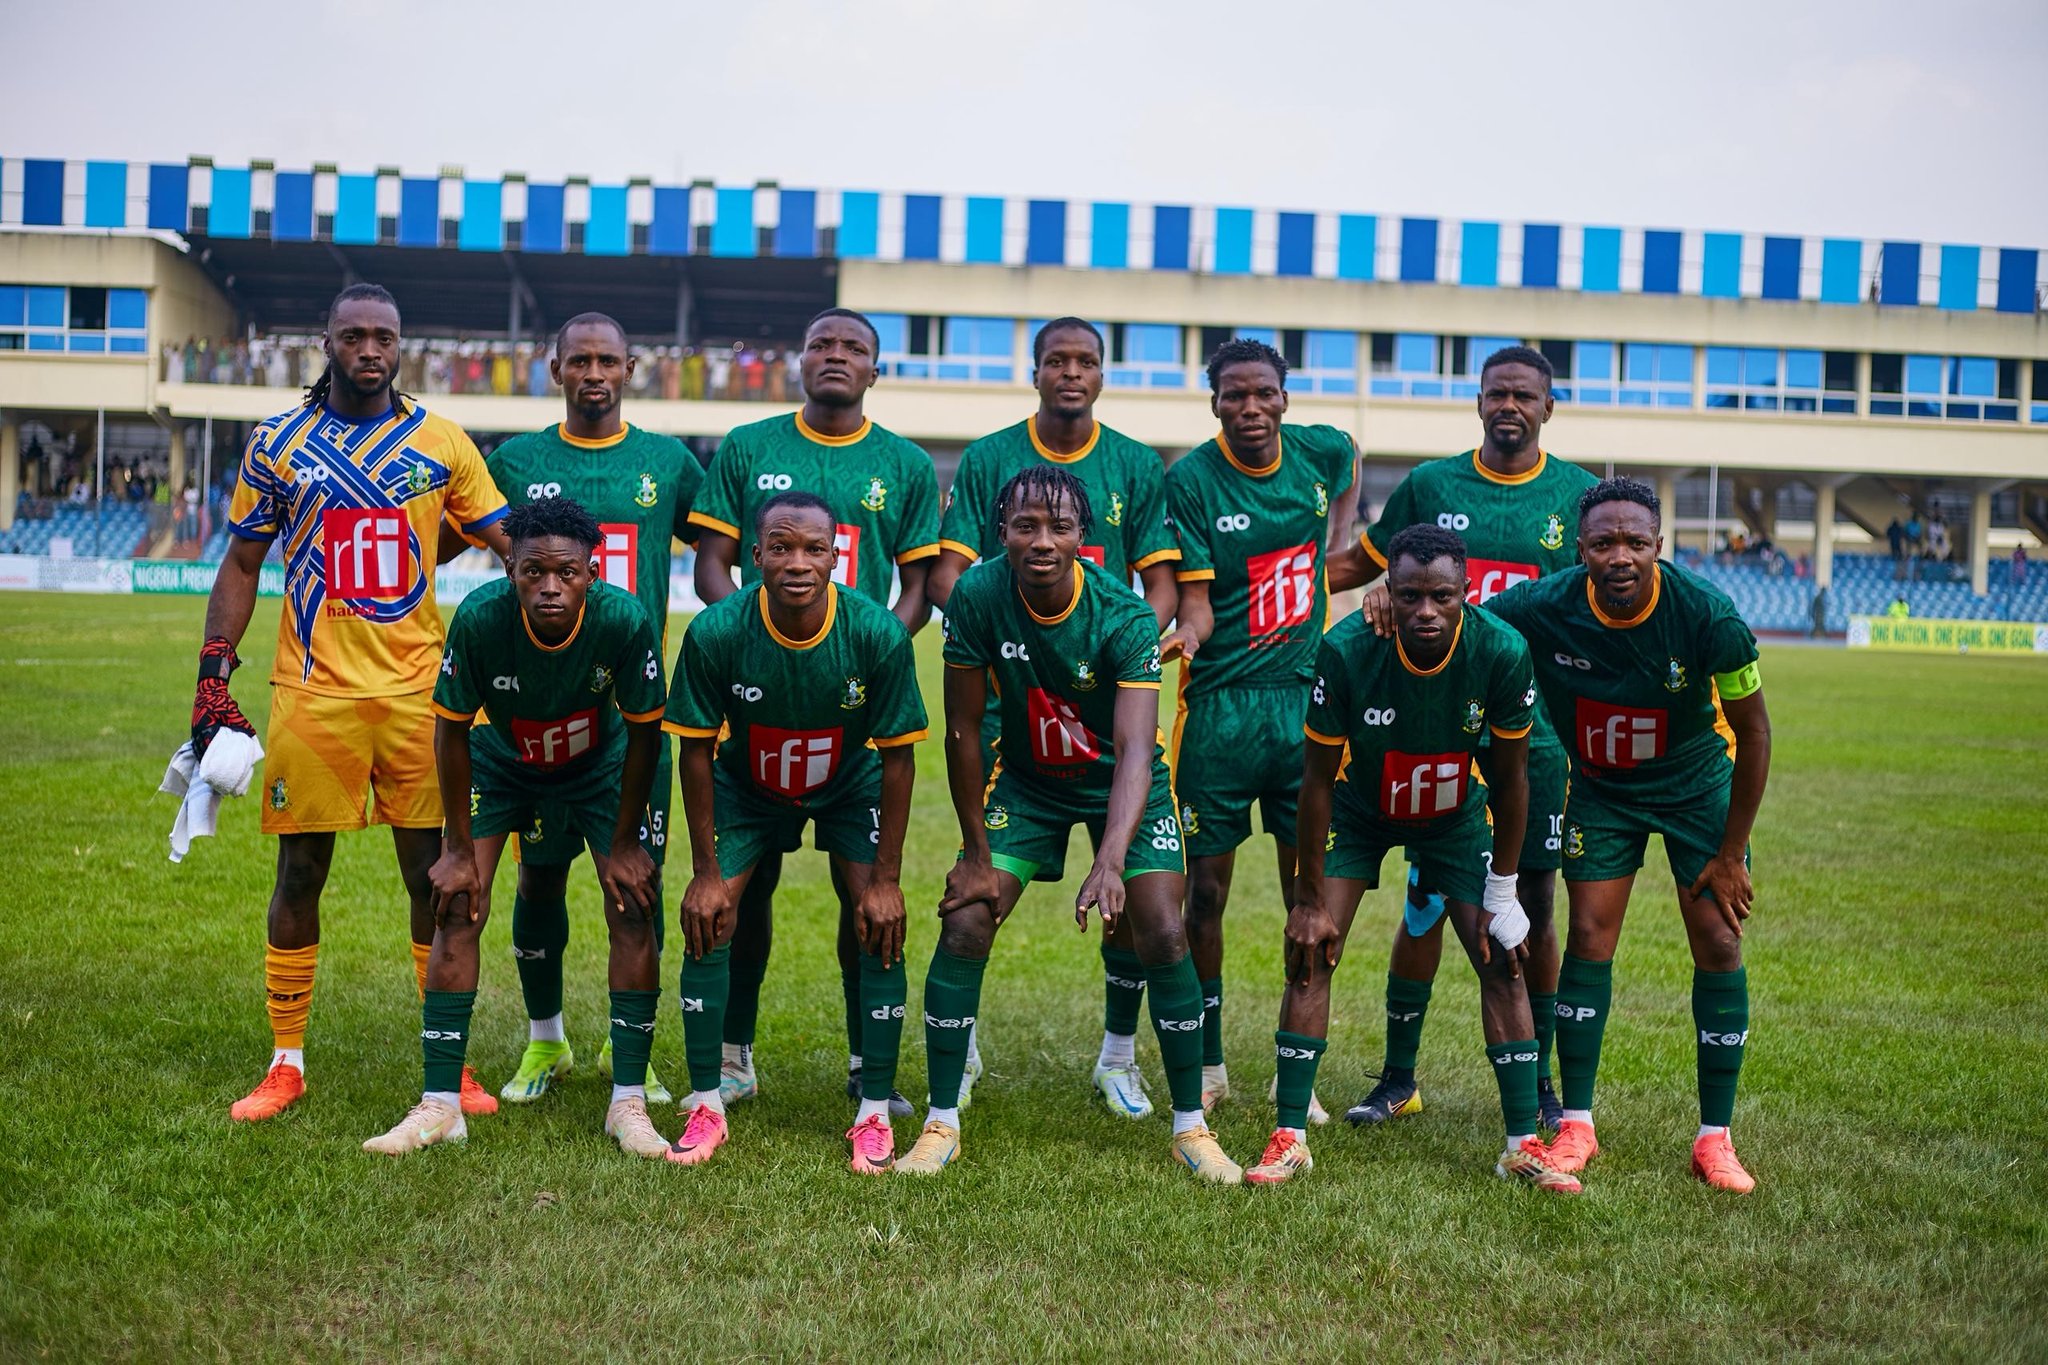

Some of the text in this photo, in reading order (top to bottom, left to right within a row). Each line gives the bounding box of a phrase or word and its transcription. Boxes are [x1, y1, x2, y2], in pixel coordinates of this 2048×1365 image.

[296, 465, 329, 486] ao
[757, 473, 792, 490] ao
[1216, 513, 1251, 533] ao
[1437, 513, 1470, 531] ao
[333, 518, 399, 589] rfi
[135, 566, 178, 589] NIGERIA
[1258, 552, 1312, 627] rfi
[326, 604, 377, 618] hausa
[1872, 623, 1889, 641] ONE
[1554, 652, 1592, 671] ao
[1739, 665, 1759, 692] C
[1364, 707, 1396, 726] ao
[523, 717, 590, 763] rfi
[1586, 715, 1657, 765] rfi
[760, 737, 833, 790] rfi
[1390, 763, 1460, 815] rfi
[1152, 815, 1176, 836] 30
[1152, 836, 1180, 851] ao
